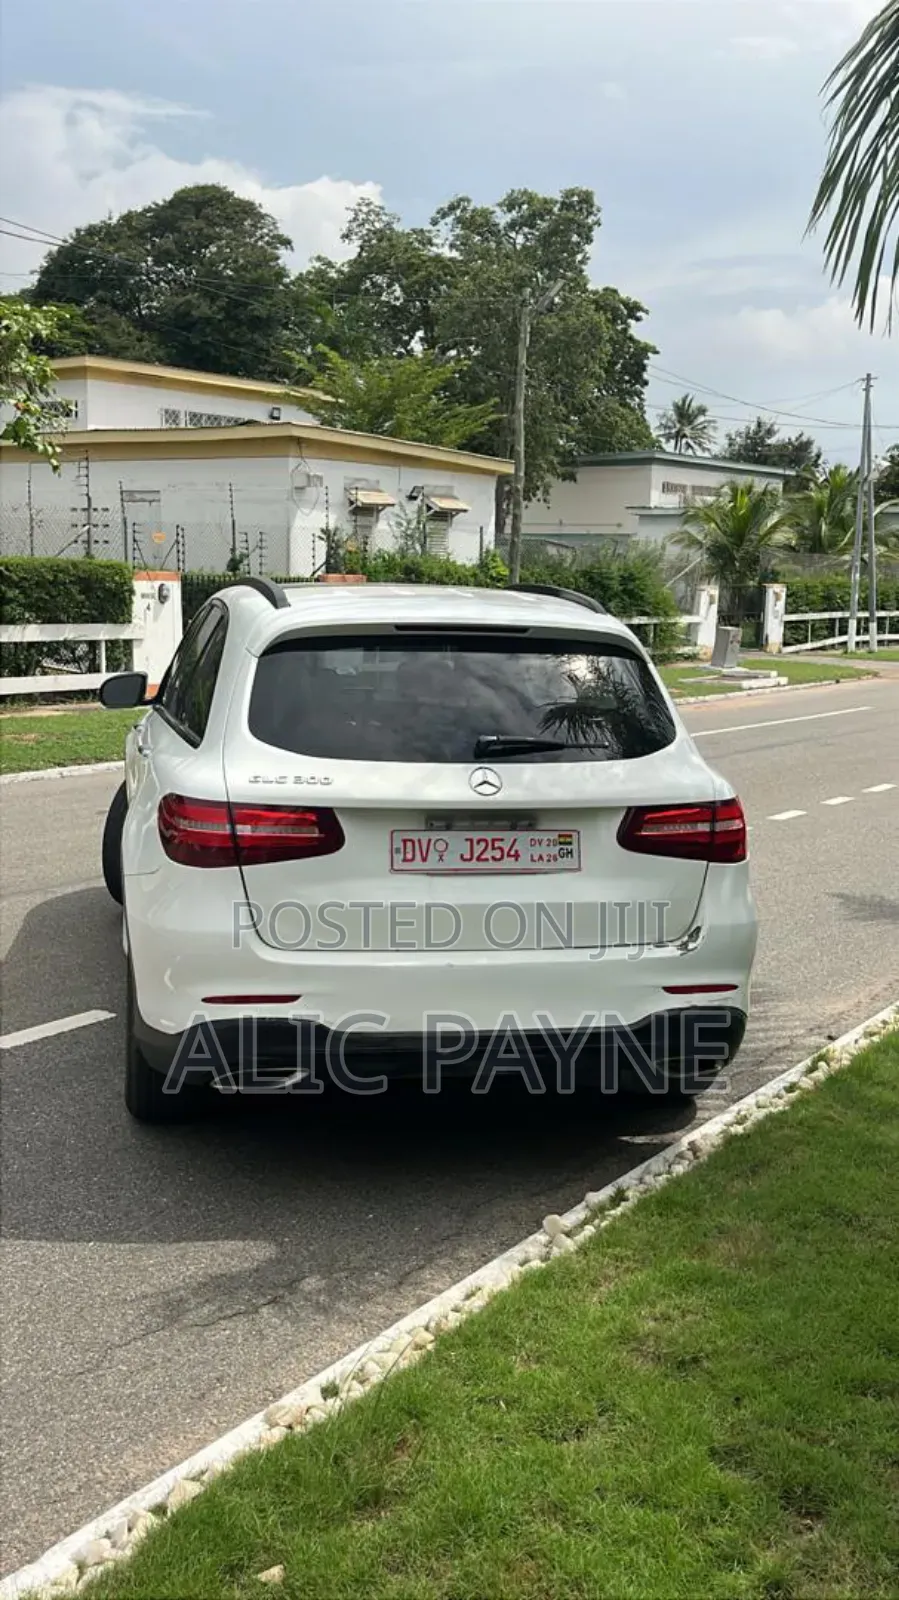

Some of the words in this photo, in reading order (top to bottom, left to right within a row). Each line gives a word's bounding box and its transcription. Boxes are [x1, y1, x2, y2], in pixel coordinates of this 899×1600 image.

[248, 775, 288, 785] GLC
[293, 775, 334, 786] 300
[529, 838, 543, 847] DV
[401, 838, 432, 862] DV
[460, 838, 521, 863] J254
[558, 847, 573, 859] GH
[529, 853, 544, 862] LA
